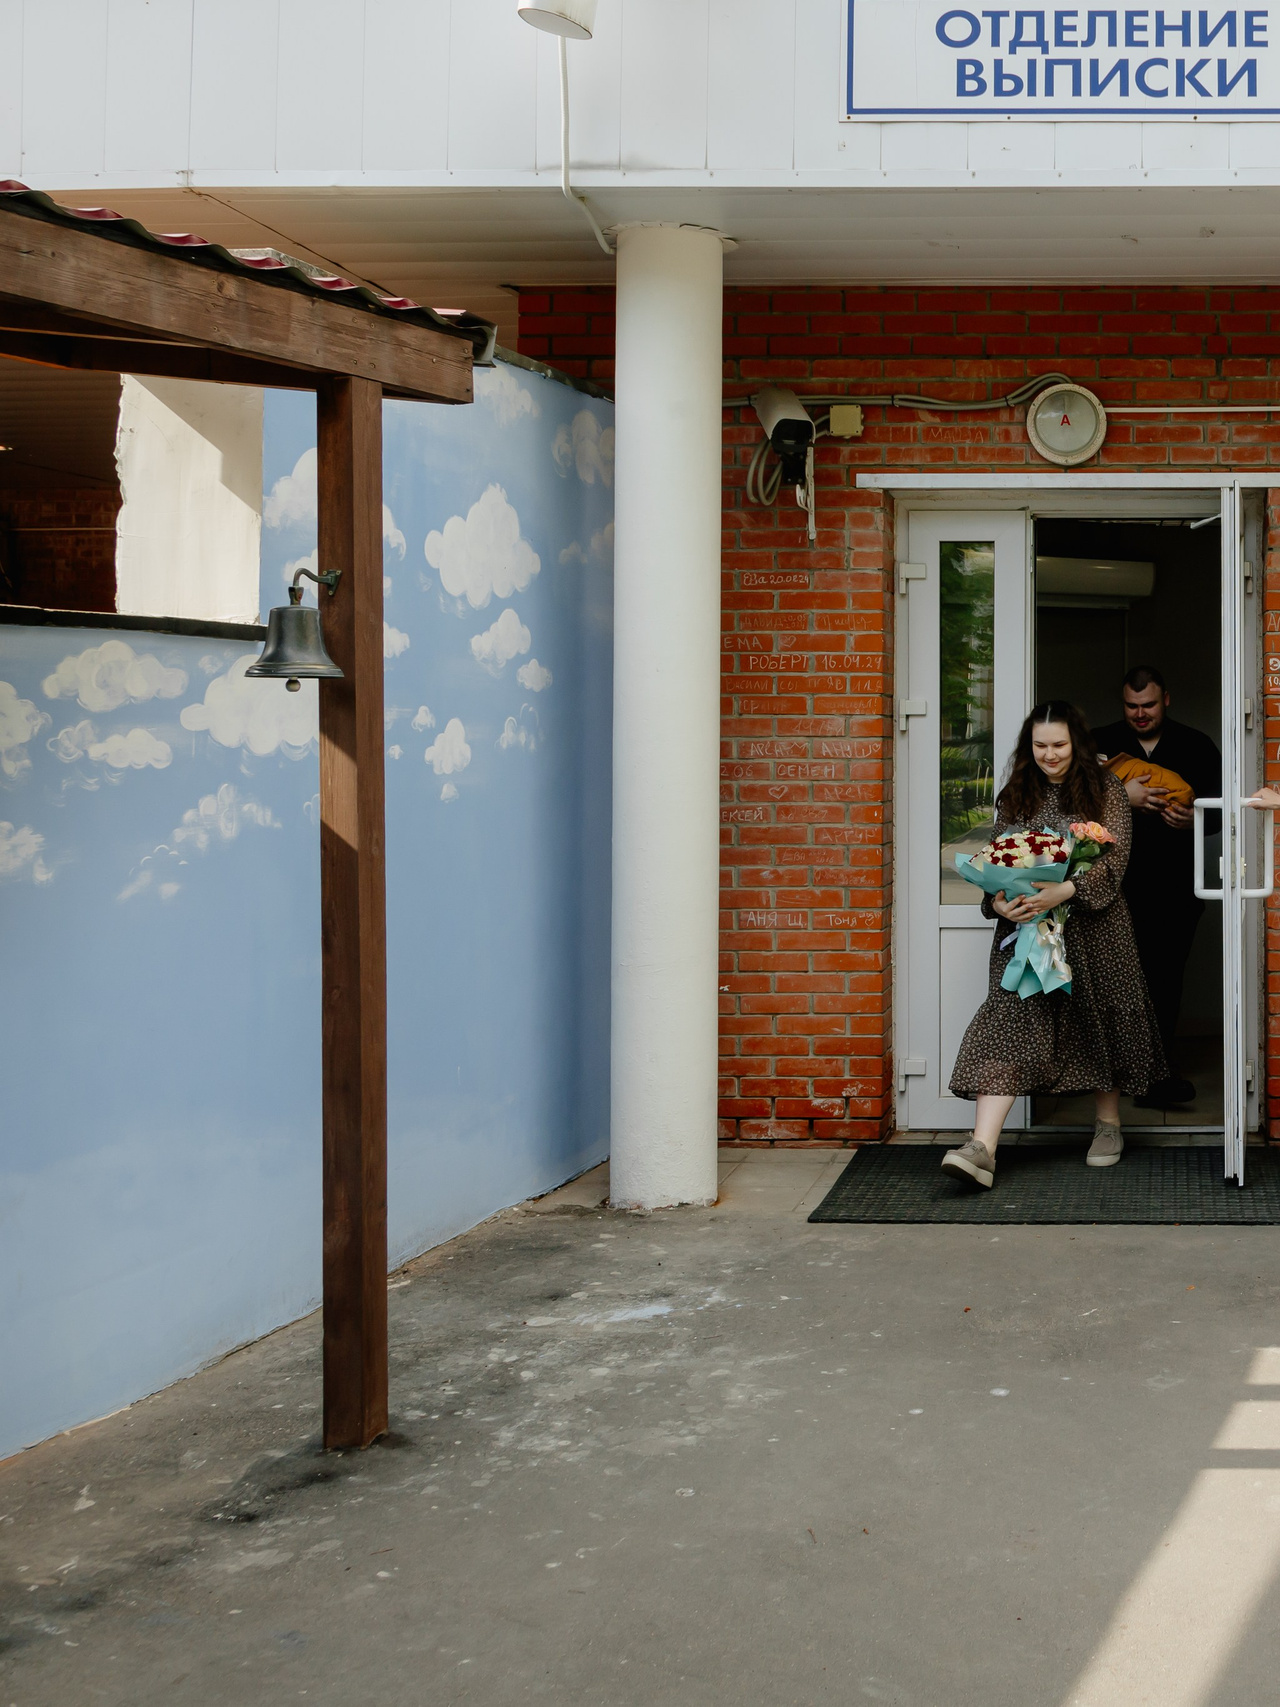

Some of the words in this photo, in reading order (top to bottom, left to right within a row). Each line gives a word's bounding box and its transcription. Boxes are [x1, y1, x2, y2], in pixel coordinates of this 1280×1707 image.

[935, 9, 1270, 56] ОТДЕЛЕНИЕ
[955, 58, 1258, 99] ВЫПИСКИ
[749, 653, 809, 670] РОБЕРТ
[776, 764, 836, 779] СЕМЕН
[746, 911, 778, 928] АНЯ
[824, 914, 858, 927] Тоня
